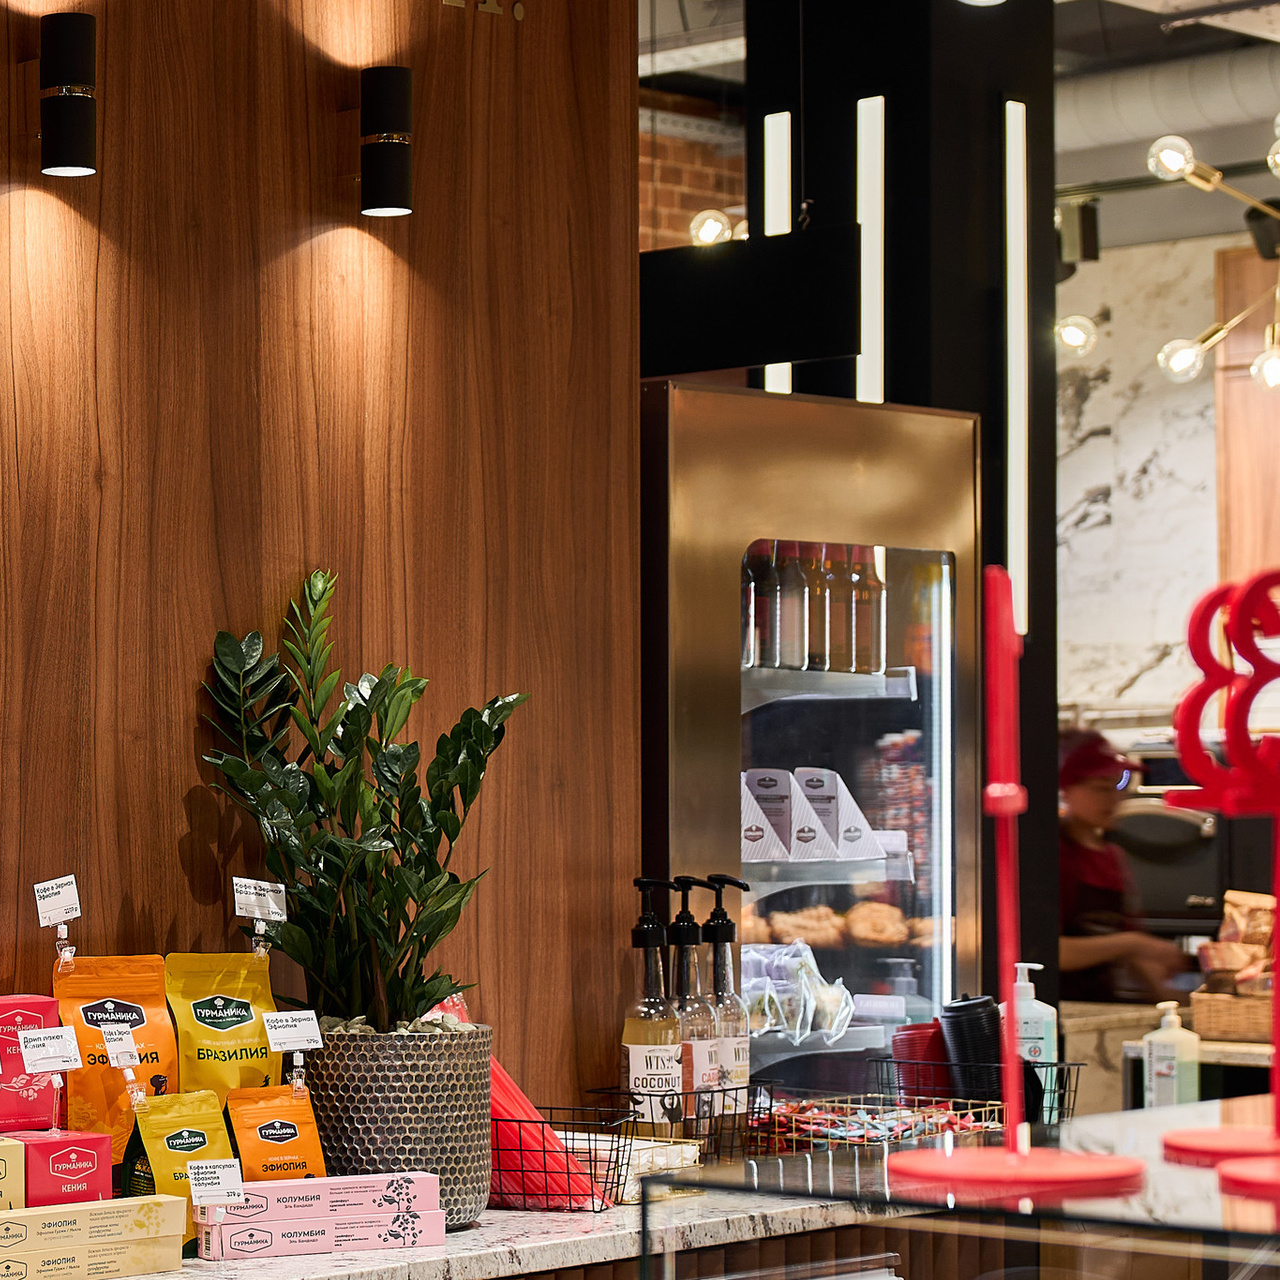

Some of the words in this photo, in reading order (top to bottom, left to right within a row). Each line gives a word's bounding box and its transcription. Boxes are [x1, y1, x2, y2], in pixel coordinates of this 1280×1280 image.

[87, 1012, 140, 1021] ГУРМАНИКА
[197, 1007, 248, 1017] ГУРМАНИКА
[0, 1024, 38, 1033] ГУРМАНИКА
[6, 1046, 22, 1054] КЕН
[197, 1047, 268, 1062] БРАЗИЛИЯ
[87, 1051, 160, 1065] ЭФИЯ
[634, 1076, 680, 1089] COCONUT
[55, 1161, 93, 1171] ГУРМАНИКА
[262, 1161, 307, 1172] ЭФИОПИЯ
[61, 1183, 87, 1192] КЕНИЯ
[277, 1194, 320, 1204] КОЛУМБИЯ
[230, 1203, 264, 1212] ГУРМАНИКА
[41, 1219, 77, 1229] ЭФИОПИЯ
[281, 1229, 326, 1239] КОЛУМБИЯ
[234, 1239, 269, 1247] ГУРМАНИКА
[40, 1256, 76, 1267] ЭФИОПИЯ
